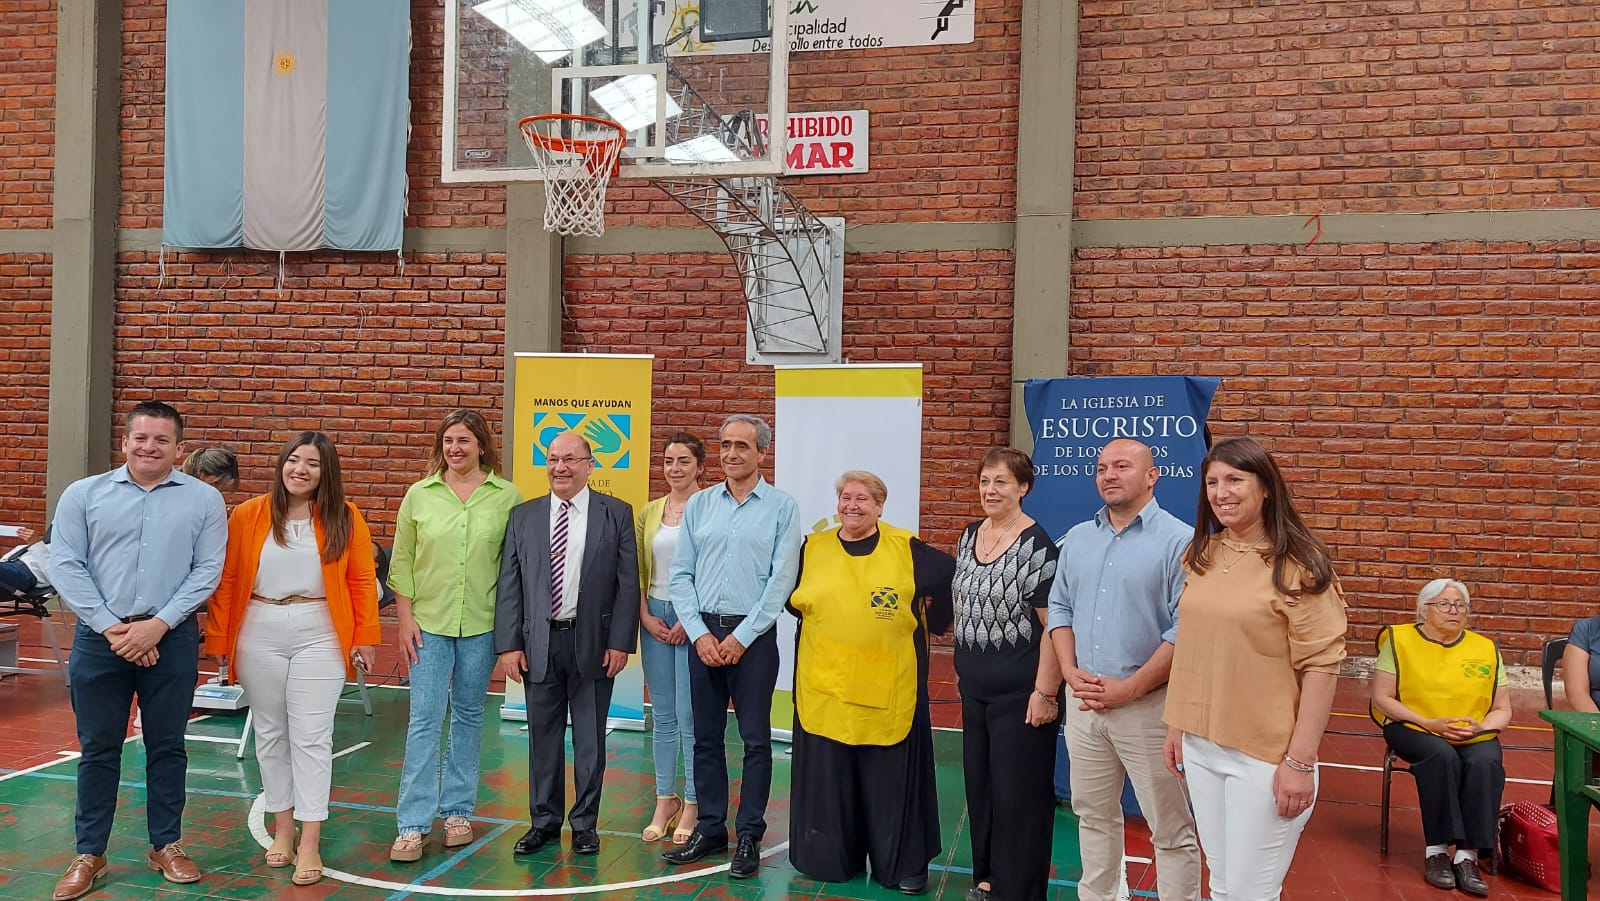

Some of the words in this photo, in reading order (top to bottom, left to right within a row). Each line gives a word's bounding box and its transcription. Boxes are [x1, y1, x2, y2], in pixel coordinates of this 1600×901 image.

[789, 17, 847, 39] ipalidad
[812, 36, 844, 49] entre
[848, 34, 884, 48] todos
[753, 141, 854, 169] MAR
[534, 398, 568, 407] MANOS
[571, 399, 590, 408] QUE
[592, 399, 632, 408] AYUDAN
[1061, 398, 1078, 410] LA
[1083, 396, 1139, 409] IGLESIA
[1144, 395, 1164, 407] DE
[1036, 415, 1197, 440] ESUCRISTO
[1054, 446, 1073, 458] DE
[1053, 464, 1079, 476] LOS
[1158, 462, 1194, 478] DÍAS
